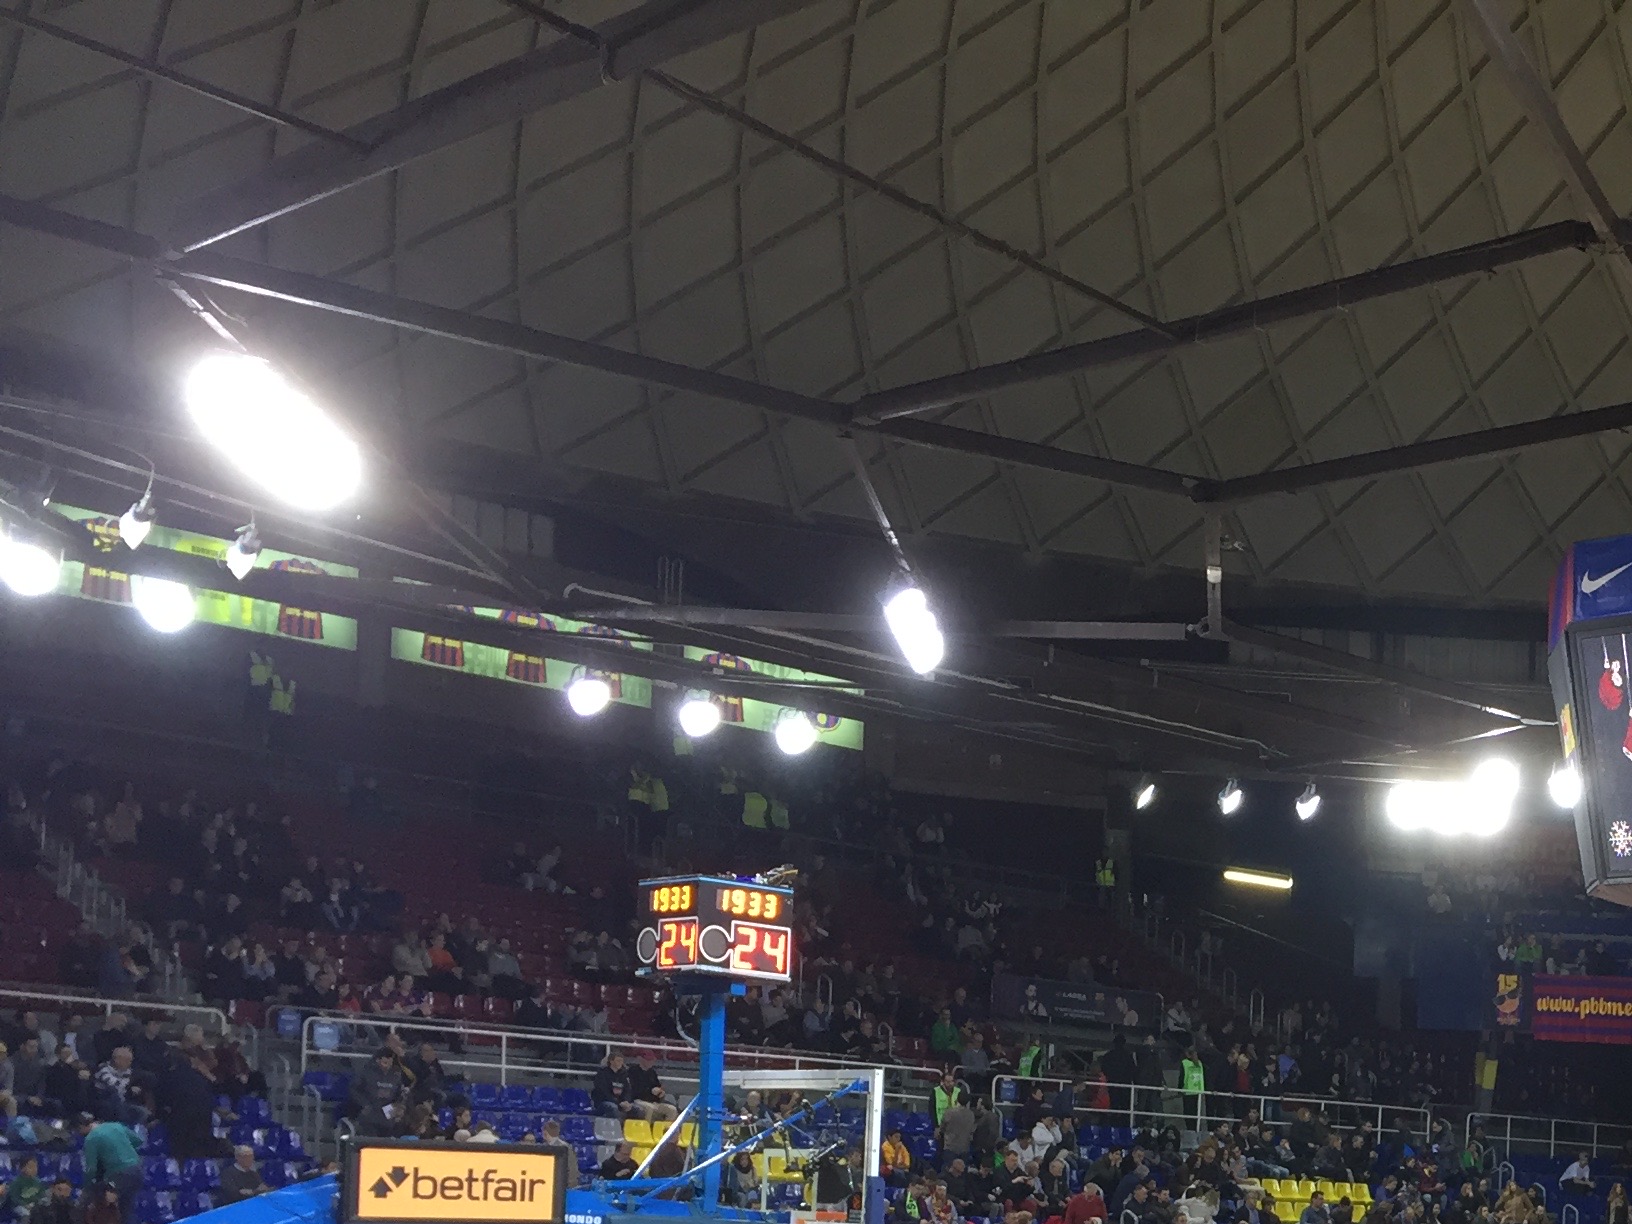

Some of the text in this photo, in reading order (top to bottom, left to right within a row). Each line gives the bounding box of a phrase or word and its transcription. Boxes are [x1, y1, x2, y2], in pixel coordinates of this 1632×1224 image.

[653, 886, 691, 912] 1933
[722, 889, 778, 919] 1933
[660, 923, 696, 966] 24
[734, 926, 787, 973] 24
[412, 1167, 546, 1202] betfair
